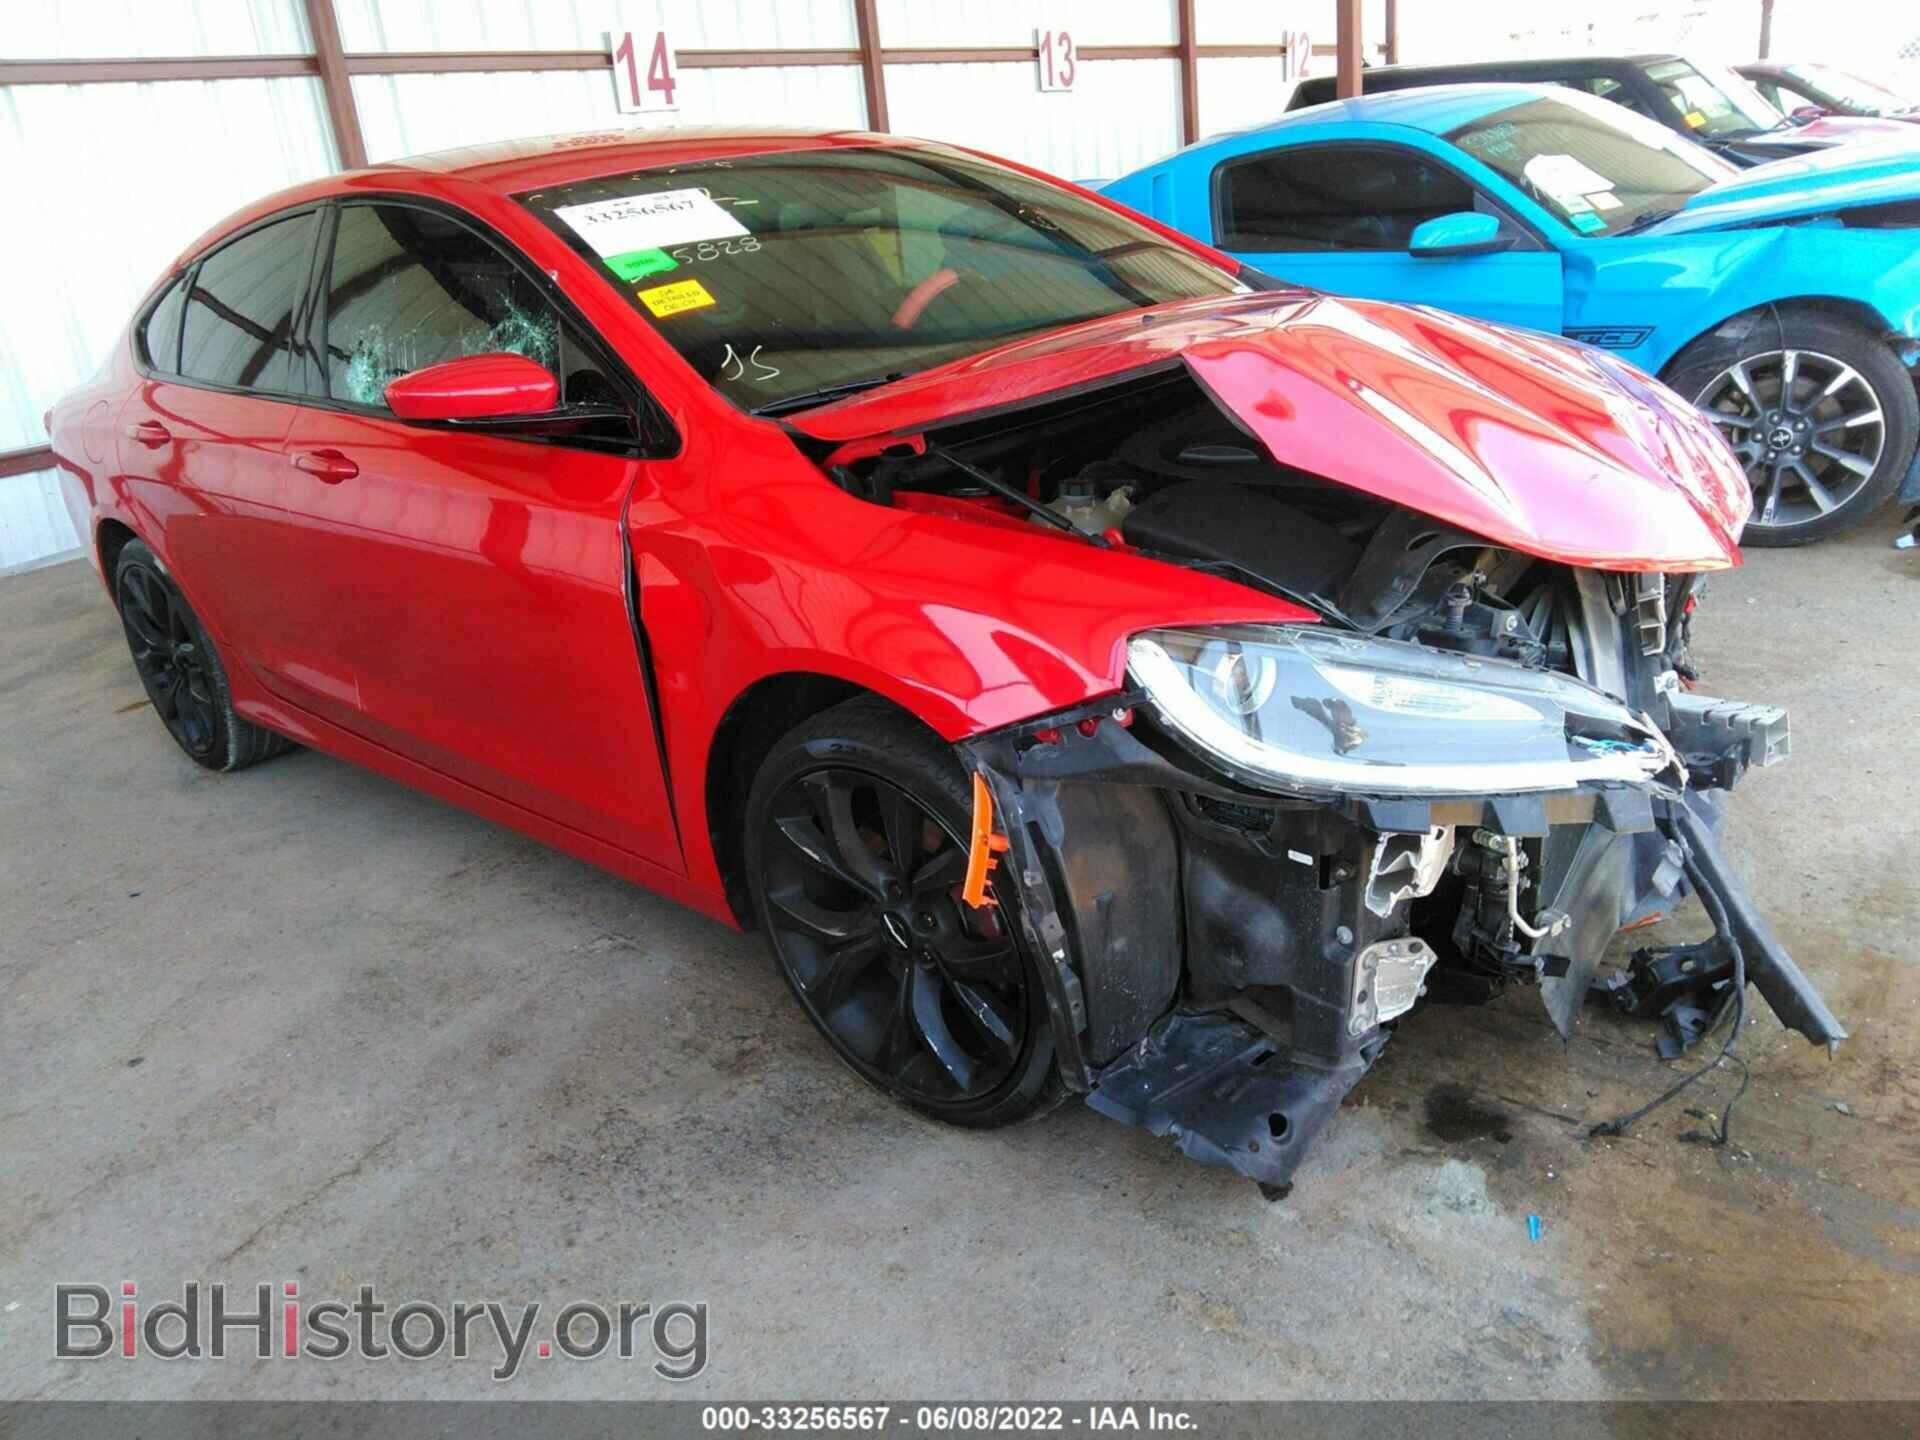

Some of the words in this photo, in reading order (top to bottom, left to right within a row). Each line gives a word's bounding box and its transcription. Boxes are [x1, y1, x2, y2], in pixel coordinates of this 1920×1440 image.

[616, 31, 676, 106] 14
[1040, 30, 1074, 88] 13
[1287, 31, 1310, 78] 12
[583, 200, 696, 226] 33256567
[672, 236, 762, 264] 5828
